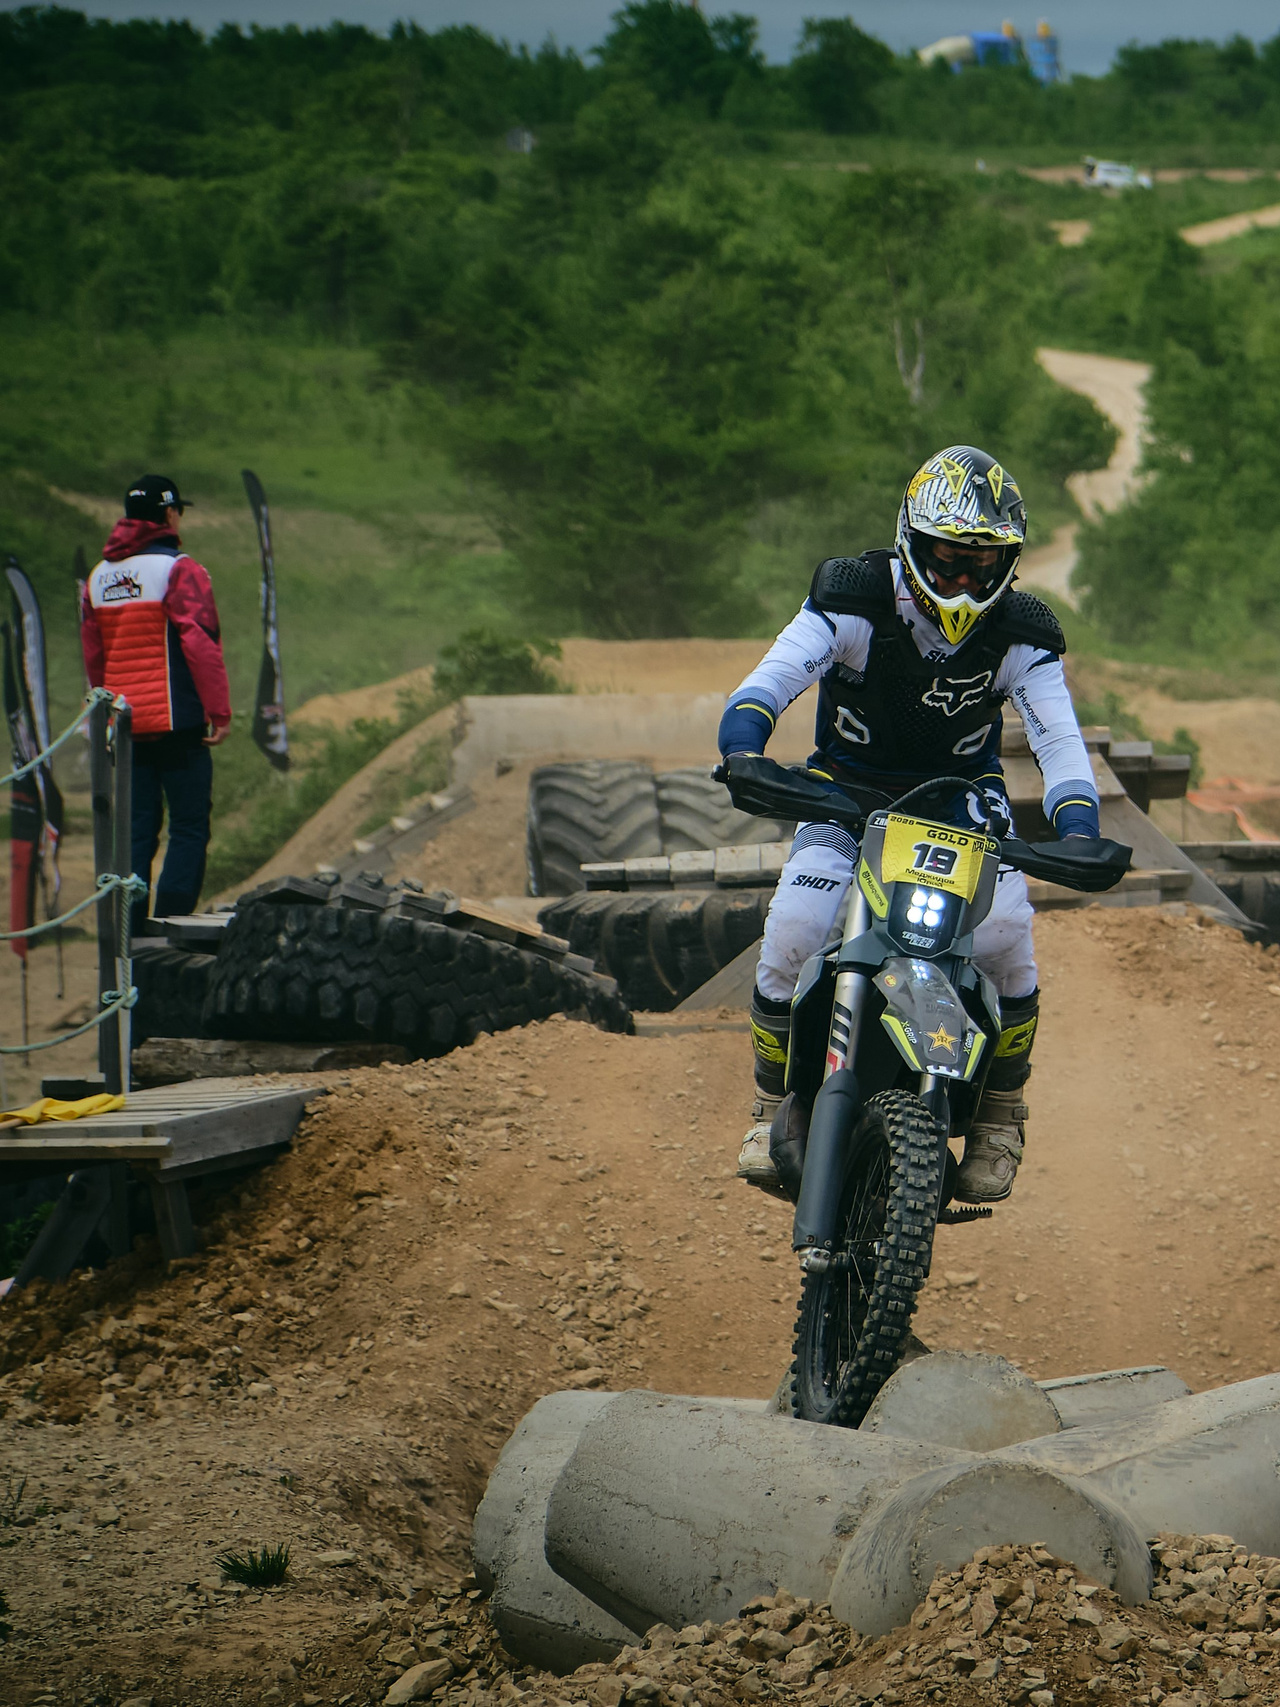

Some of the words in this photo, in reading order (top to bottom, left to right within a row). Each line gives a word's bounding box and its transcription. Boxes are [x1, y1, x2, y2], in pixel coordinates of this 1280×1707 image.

[1019, 693, 1048, 735] Husqvarna
[926, 829, 969, 847] GOLD
[912, 842, 958, 875] 19
[790, 874, 841, 892] SHOT
